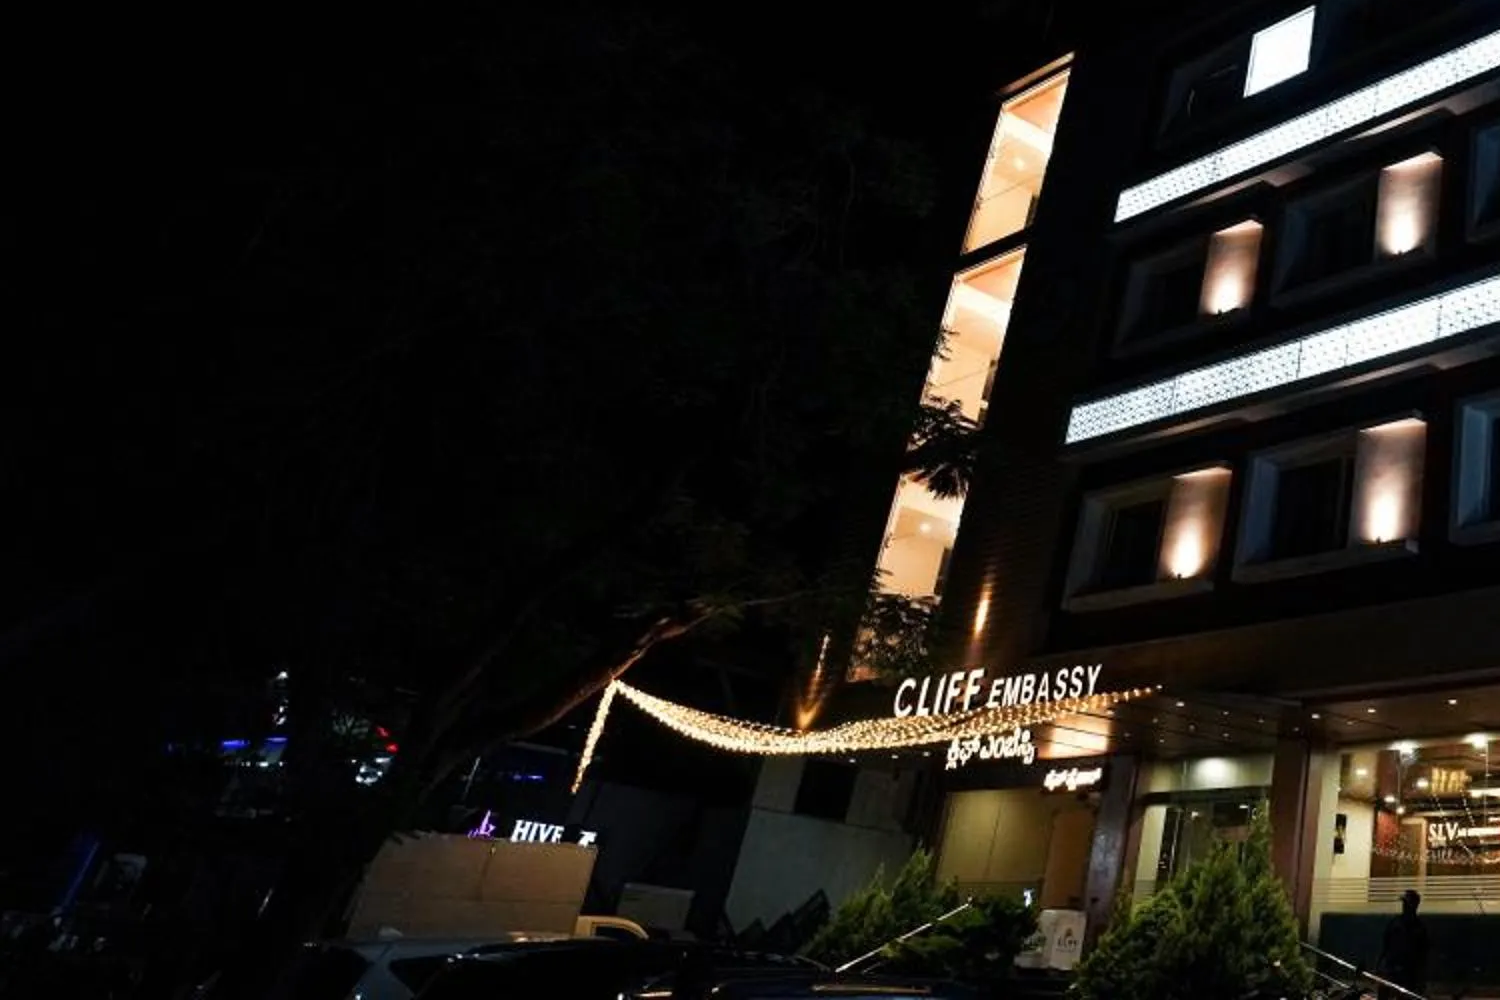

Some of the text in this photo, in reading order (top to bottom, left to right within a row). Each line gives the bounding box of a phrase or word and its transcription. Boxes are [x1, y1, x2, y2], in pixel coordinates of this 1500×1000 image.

[893, 663, 1103, 718] CLIFF EMBASSY
[510, 819, 565, 843] HIVE
[1428, 821, 1459, 841] SLV
